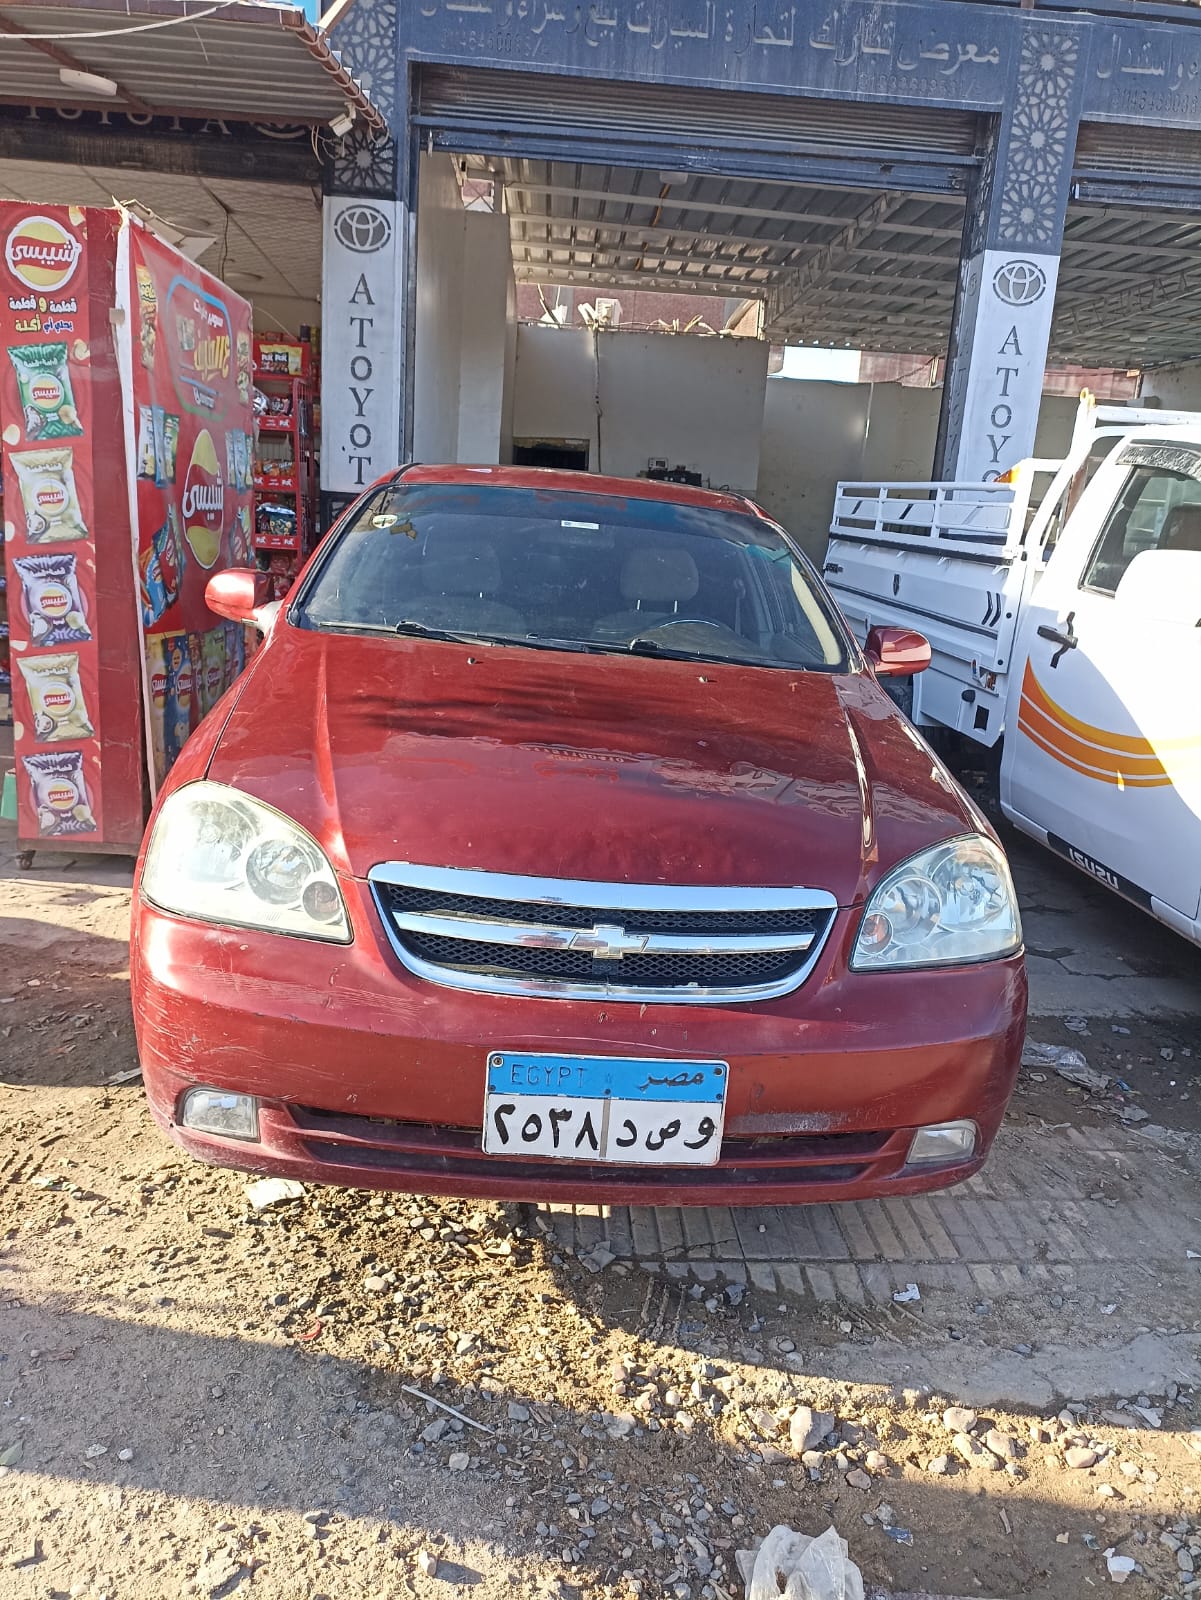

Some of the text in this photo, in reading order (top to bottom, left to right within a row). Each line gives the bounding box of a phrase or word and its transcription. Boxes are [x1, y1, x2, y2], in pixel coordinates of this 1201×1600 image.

[896, 28, 1000, 75] معرض
[1069, 847, 1120, 890] ISUZU
[510, 1064, 588, 1089] EGYPT
[637, 1070, 705, 1094] مصر
[494, 1104, 600, 1151] ٢٥٣٨
